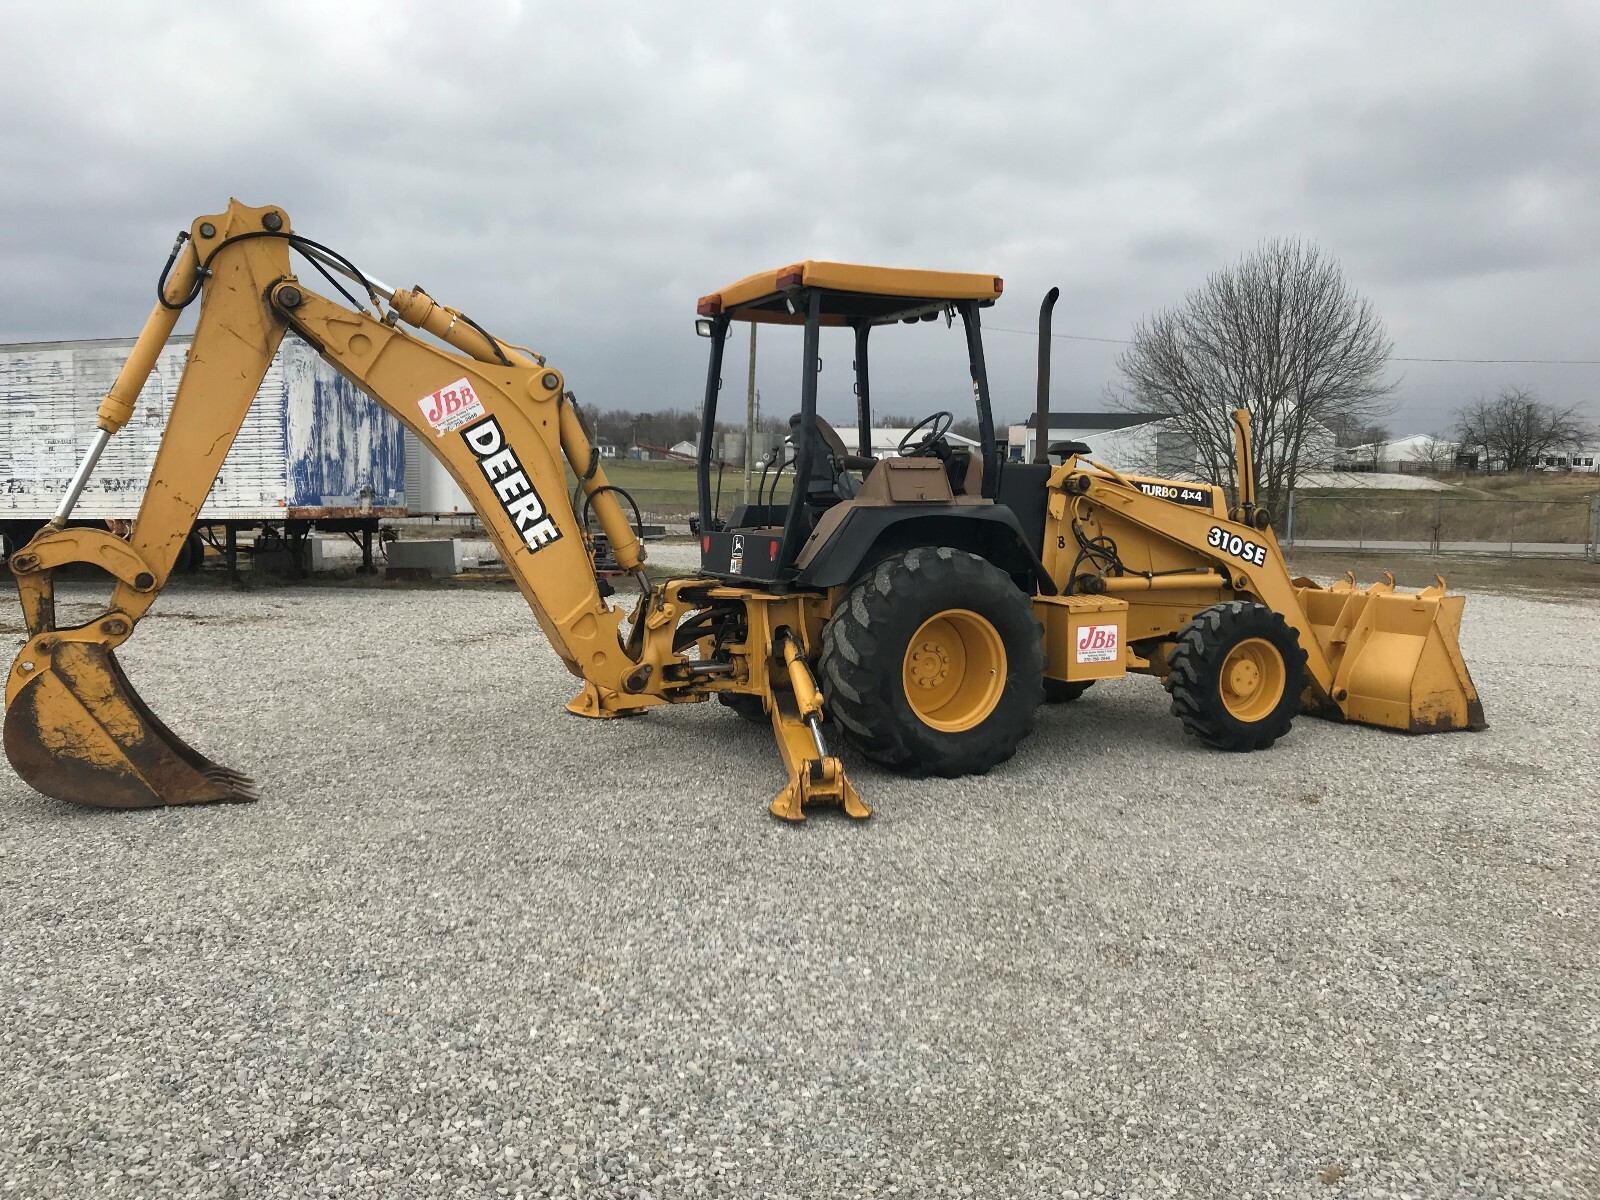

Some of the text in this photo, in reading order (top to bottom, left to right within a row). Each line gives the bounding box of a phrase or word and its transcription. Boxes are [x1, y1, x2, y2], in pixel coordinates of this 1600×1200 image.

[429, 388, 474, 422] JBB
[464, 419, 559, 551] DEERE
[1141, 484, 1203, 502] TURBO 4x4
[1207, 526, 1267, 567] 310SE
[1079, 626, 1116, 650] JBB
